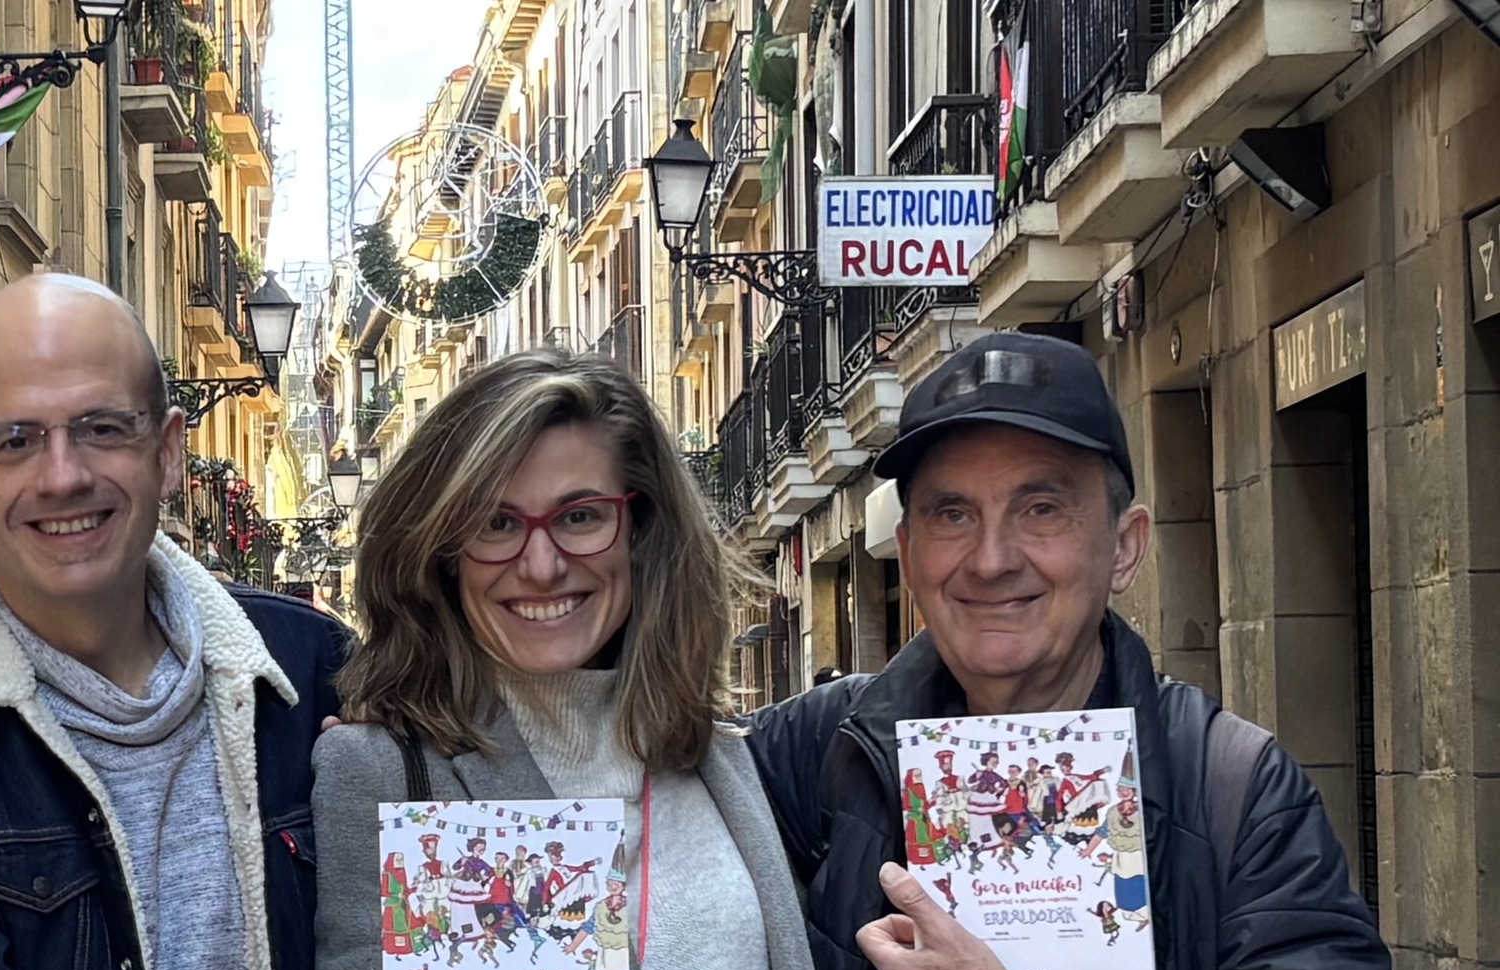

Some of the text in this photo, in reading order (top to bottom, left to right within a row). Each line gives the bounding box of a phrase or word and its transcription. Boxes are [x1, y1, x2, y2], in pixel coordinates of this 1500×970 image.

[825, 189, 995, 229] ELECTRICIDAD
[841, 239, 970, 278] RUCAL
[972, 878, 1011, 897] Gora
